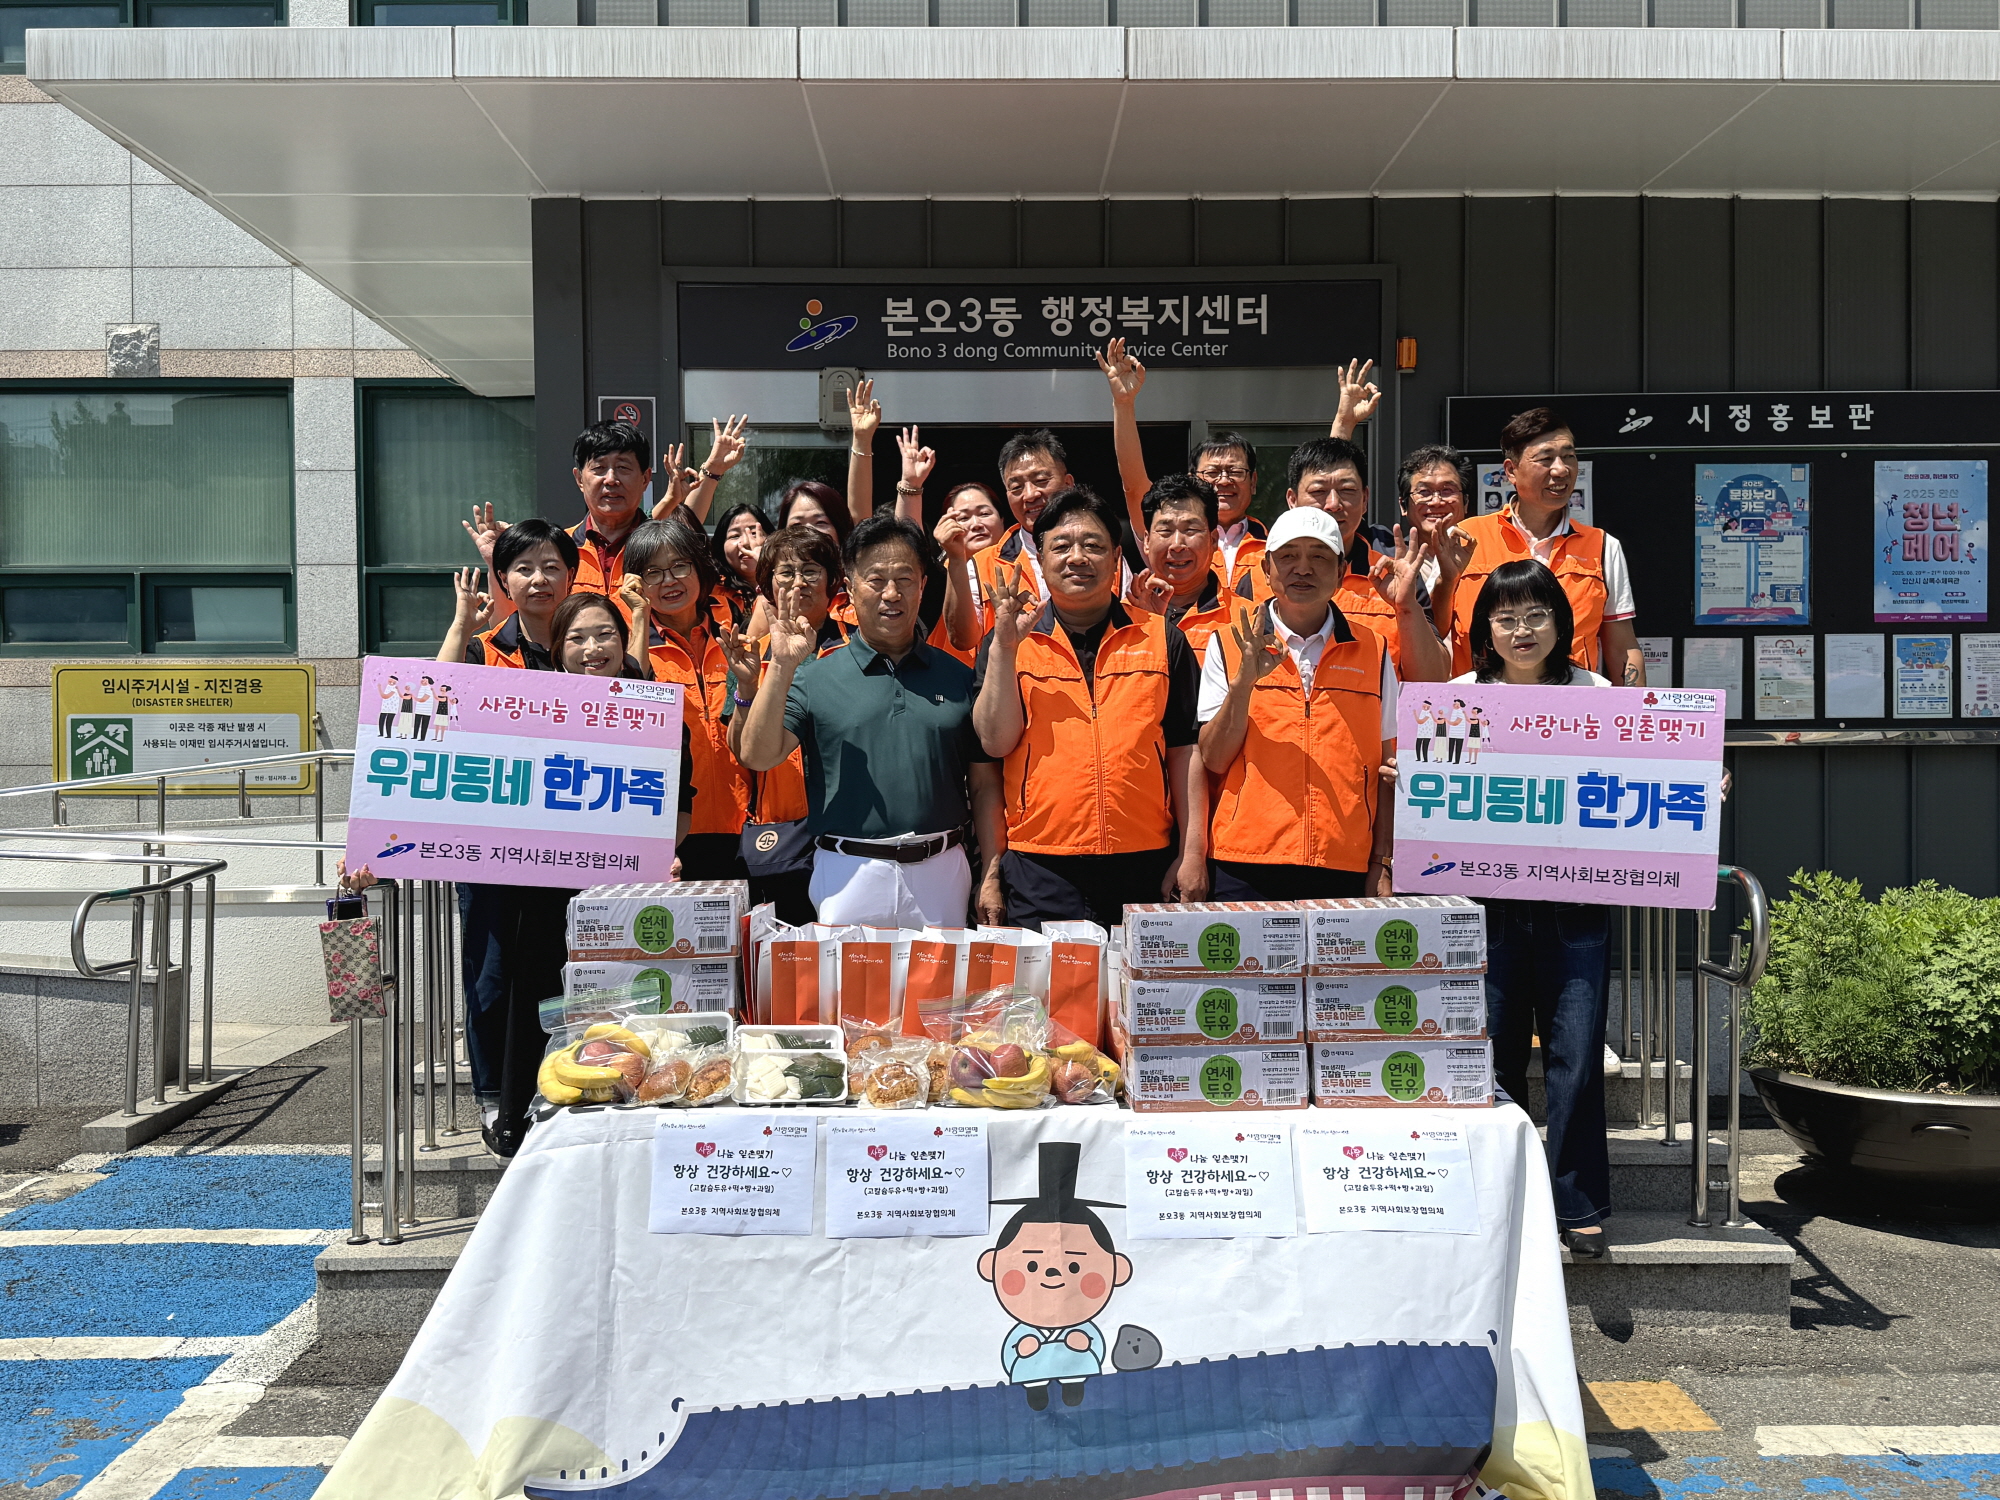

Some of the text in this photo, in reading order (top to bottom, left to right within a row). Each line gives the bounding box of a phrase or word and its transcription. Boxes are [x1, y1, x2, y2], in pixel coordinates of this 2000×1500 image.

[881, 294, 1268, 337] 본오3동 행정복지센터
[887, 344, 932, 358] Bono
[938, 344, 946, 358] 3
[953, 343, 997, 361] dong
[1004, 343, 1102, 360] Community
[1171, 342, 1228, 356] Center
[1730, 489, 1775, 500] 문화누리
[1903, 489, 1959, 499] 2025 안산
[1742, 502, 1764, 512] 카드
[1903, 502, 1959, 531] 청년
[1902, 533, 1959, 562] 페어
[102, 678, 190, 694] 임시주거시설
[204, 678, 263, 694] 지진겸용
[625, 684, 674, 696] 사랑의열매
[132, 697, 233, 708] (DISASTER SHELTER)
[1661, 693, 1715, 704] 사랑의열매
[479, 696, 666, 730] 사랑나눔 일촌맺기
[169, 722, 266, 732] 이곳은 각종 재난 발생 시
[1509, 714, 1706, 741] 사랑나눔 일촌맺기
[143, 739, 289, 749] 사용되는 이재민 임시주거시설입니다.
[367, 749, 666, 816] 우리동네 한가족
[1408, 772, 1707, 831] 우리동네 한가족
[418, 841, 640, 871] 본오3동 지역사회보장협의체
[1459, 861, 1680, 888] 본오3동 지역사회보장협의체
[640, 916, 667, 930] 연세
[577, 933, 624, 941] 호두&아몬드
[641, 931, 667, 945] 두유
[1206, 932, 1235, 947] 연세
[1384, 929, 1413, 943] 연세
[1140, 949, 1189, 958] 호두&아몬드
[1207, 949, 1235, 964] 두유
[1317, 946, 1366, 955] 호두&아몬드
[1385, 946, 1413, 961] 두유
[1202, 999, 1230, 1013] 연세
[1337, 1003, 1350, 1011] 두유
[1383, 995, 1411, 1010] 연세
[1137, 1008, 1157, 1016] 고칼슘
[1316, 1012, 1365, 1021] 호두&아몬드
[1384, 1011, 1412, 1026] 두유
[1137, 1017, 1186, 1026] 호두&아몬드
[1203, 1016, 1231, 1030] 두유
[1206, 1066, 1234, 1081] 연세
[1388, 1063, 1417, 1077] 연세
[1141, 1083, 1189, 1091] 호두&아몬드
[1321, 1078, 1371, 1088] 호두&아몬드
[1390, 1080, 1418, 1094] 두유
[1207, 1083, 1235, 1098] 두유
[717, 1150, 734, 1158] 나눔
[739, 1150, 773, 1159] 일촌맺기
[889, 1151, 906, 1161] 나눔
[911, 1151, 945, 1161] 일촌맺기
[1190, 1155, 1208, 1163] 나눔
[1212, 1154, 1248, 1163] 일촌맺기
[1367, 1152, 1385, 1160] 나눔
[1389, 1152, 1425, 1161] 일촌맺기
[673, 1164, 779, 1179] 항상 건강하세요~
[847, 1167, 952, 1183] 항상 건강하세요~
[1146, 1169, 1256, 1184] 항상 건강하세요~
[1323, 1166, 1436, 1180] 항상 건강하세요~
[681, 1207, 780, 1216] 본오3동 지역사회보장협의체
[857, 1209, 955, 1219] 본오3동 지역사회보장협의체
[1159, 1211, 1262, 1220] 본오3동 지역사회보장협의체
[1339, 1205, 1444, 1215] 본오3동 지역사회보장협의체
